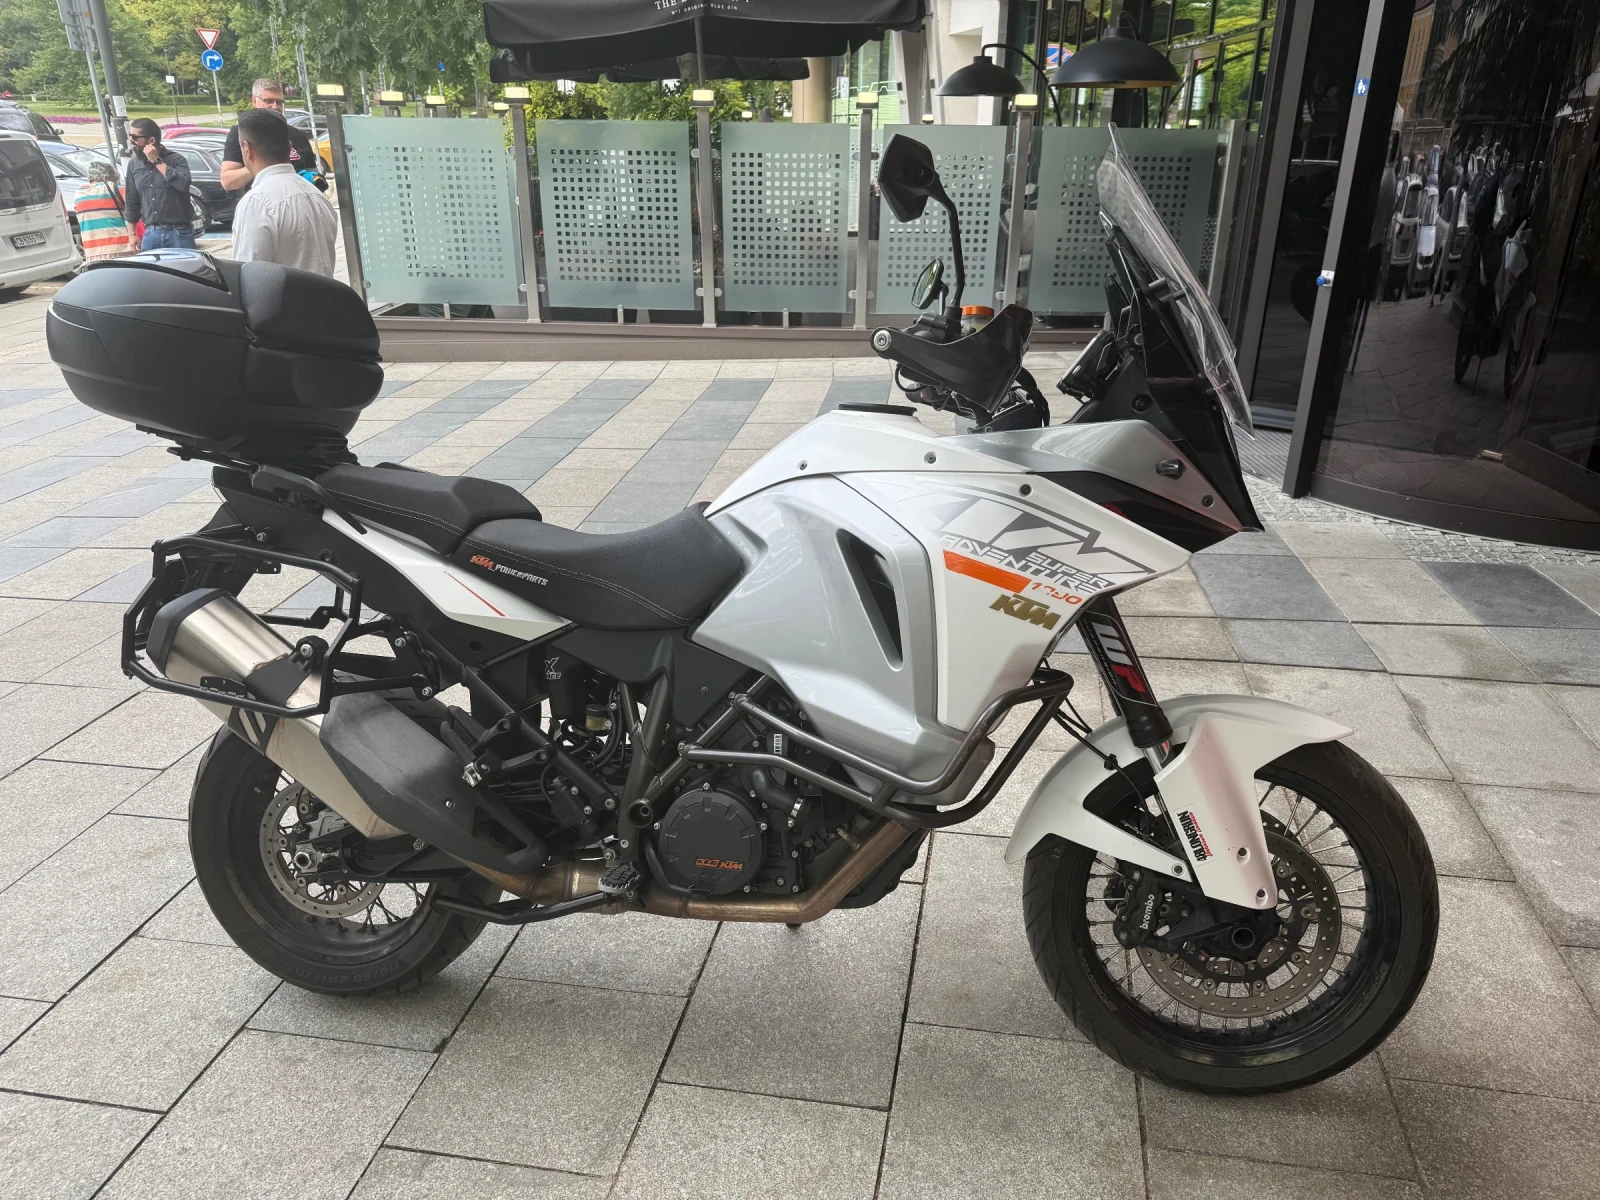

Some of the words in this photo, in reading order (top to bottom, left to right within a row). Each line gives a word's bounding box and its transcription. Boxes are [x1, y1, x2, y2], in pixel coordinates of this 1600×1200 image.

[654, 0, 677, 10] THE
[470, 555, 495, 569] KTM
[495, 564, 549, 586] POWERPARTS
[939, 534, 1100, 594] ADVENTURE
[1024, 550, 1110, 590] SUPER
[989, 593, 1062, 631] KTM
[1139, 894, 1155, 930] brembo
